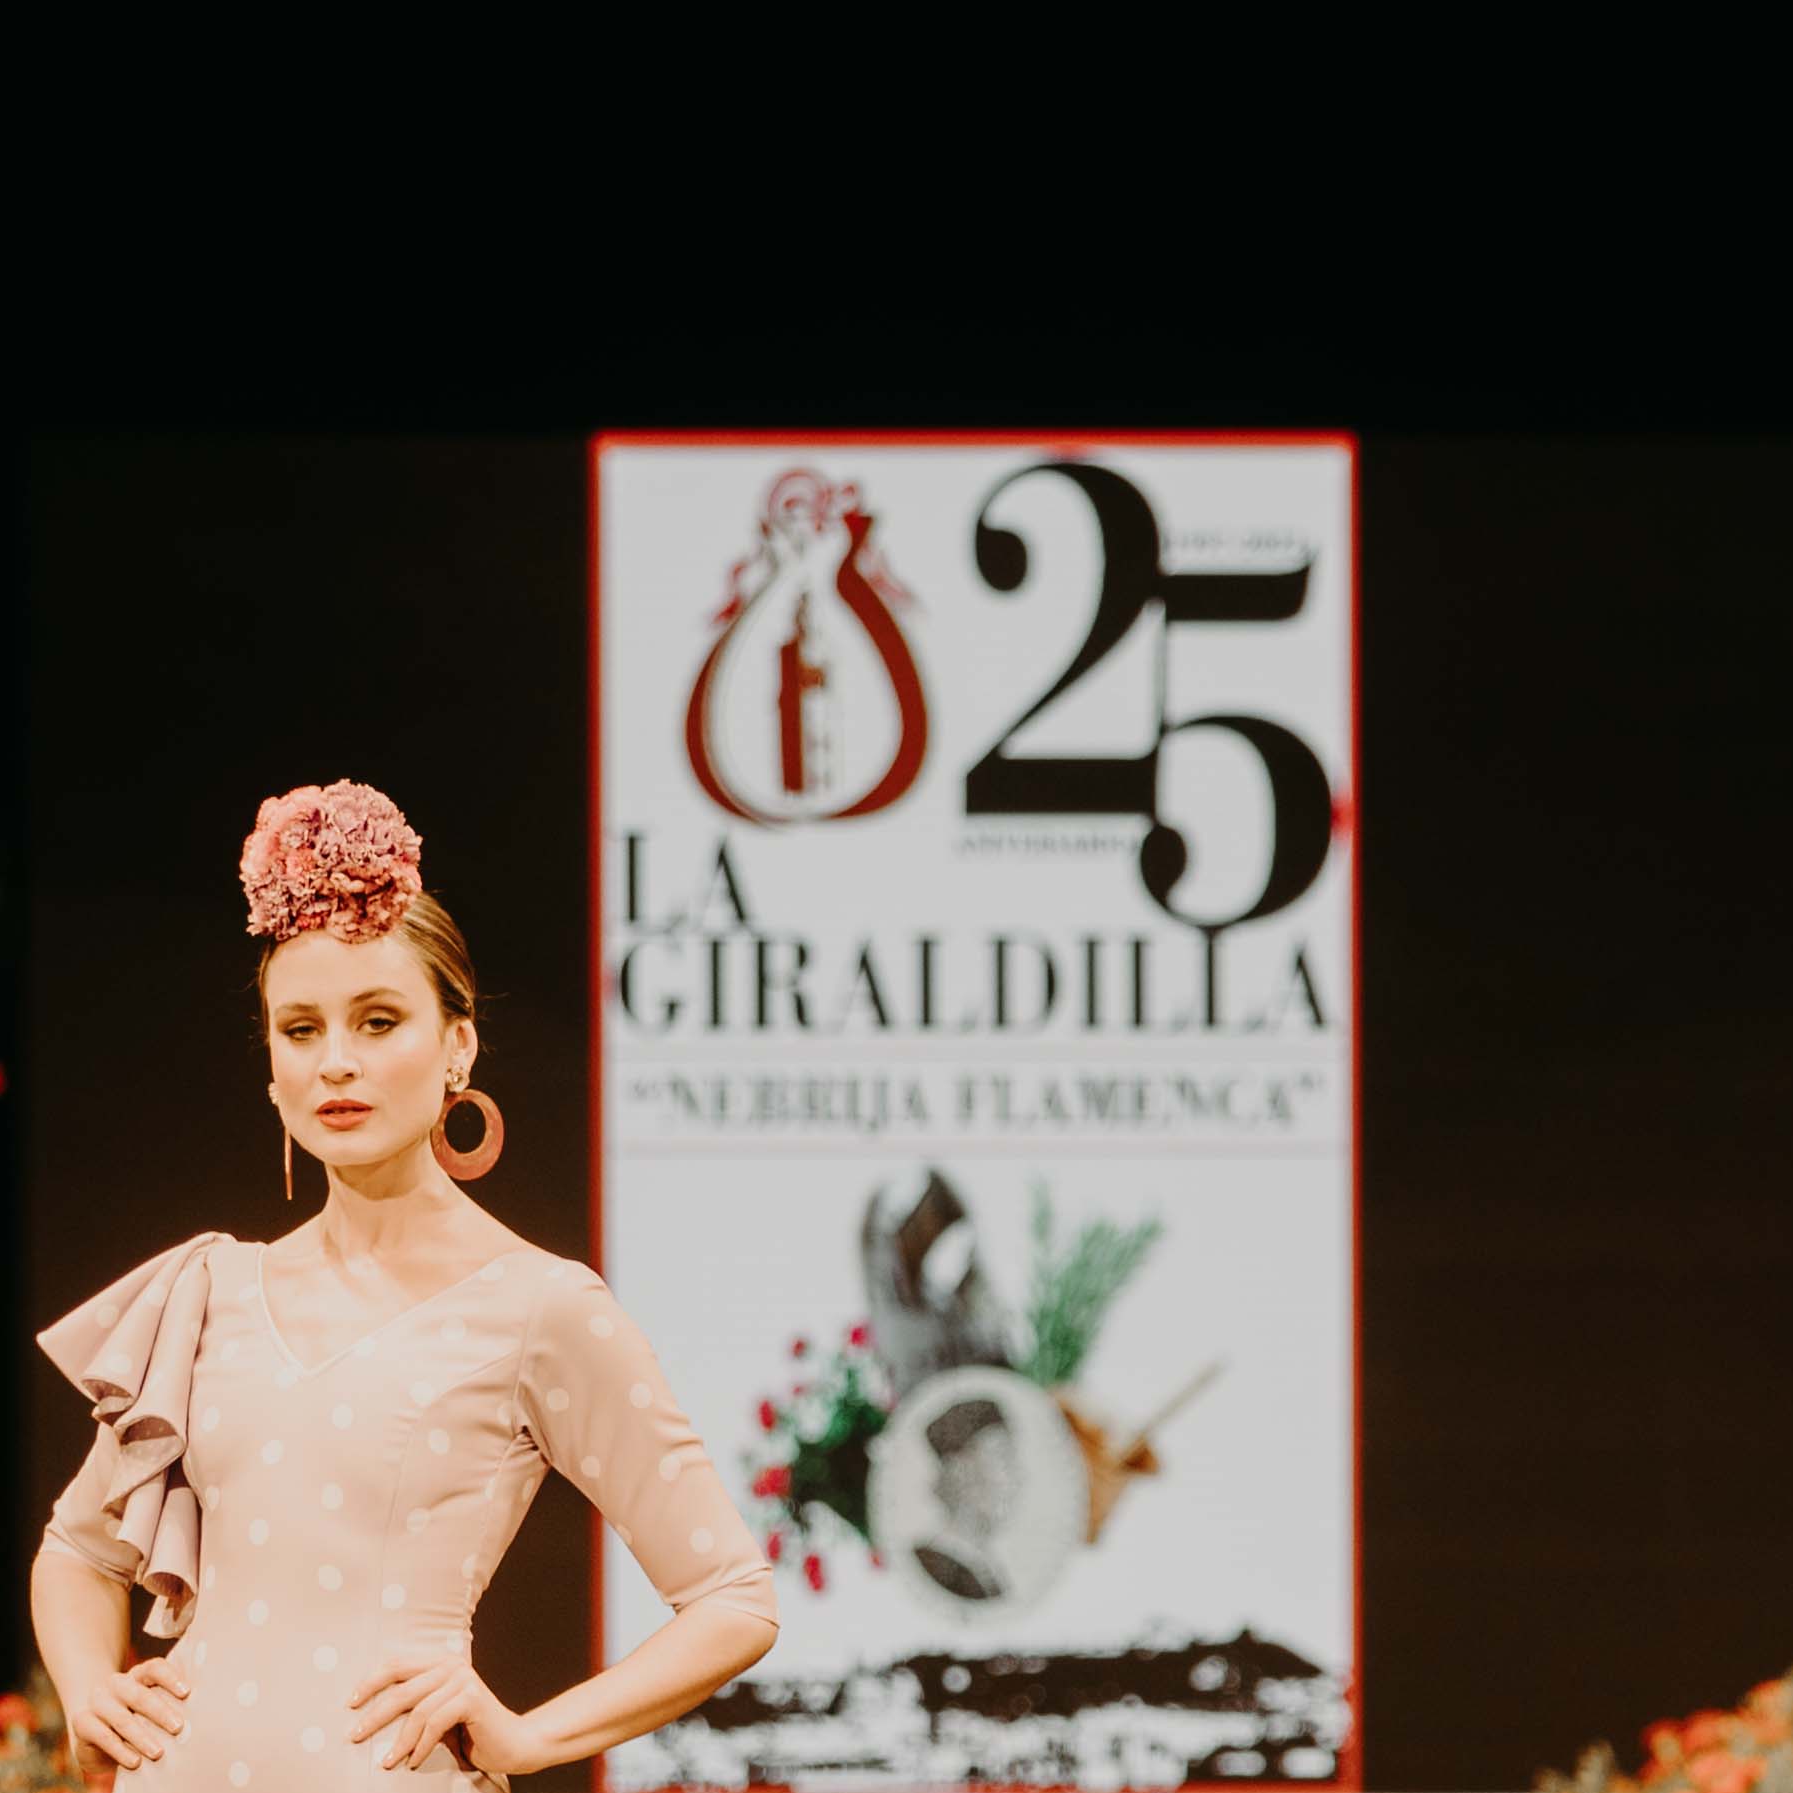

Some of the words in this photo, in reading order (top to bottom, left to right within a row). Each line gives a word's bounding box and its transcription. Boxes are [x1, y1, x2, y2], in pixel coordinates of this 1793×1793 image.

[965, 461, 1332, 927] 25
[618, 832, 759, 938] LA
[618, 934, 1338, 1036] GIRALDILLA
